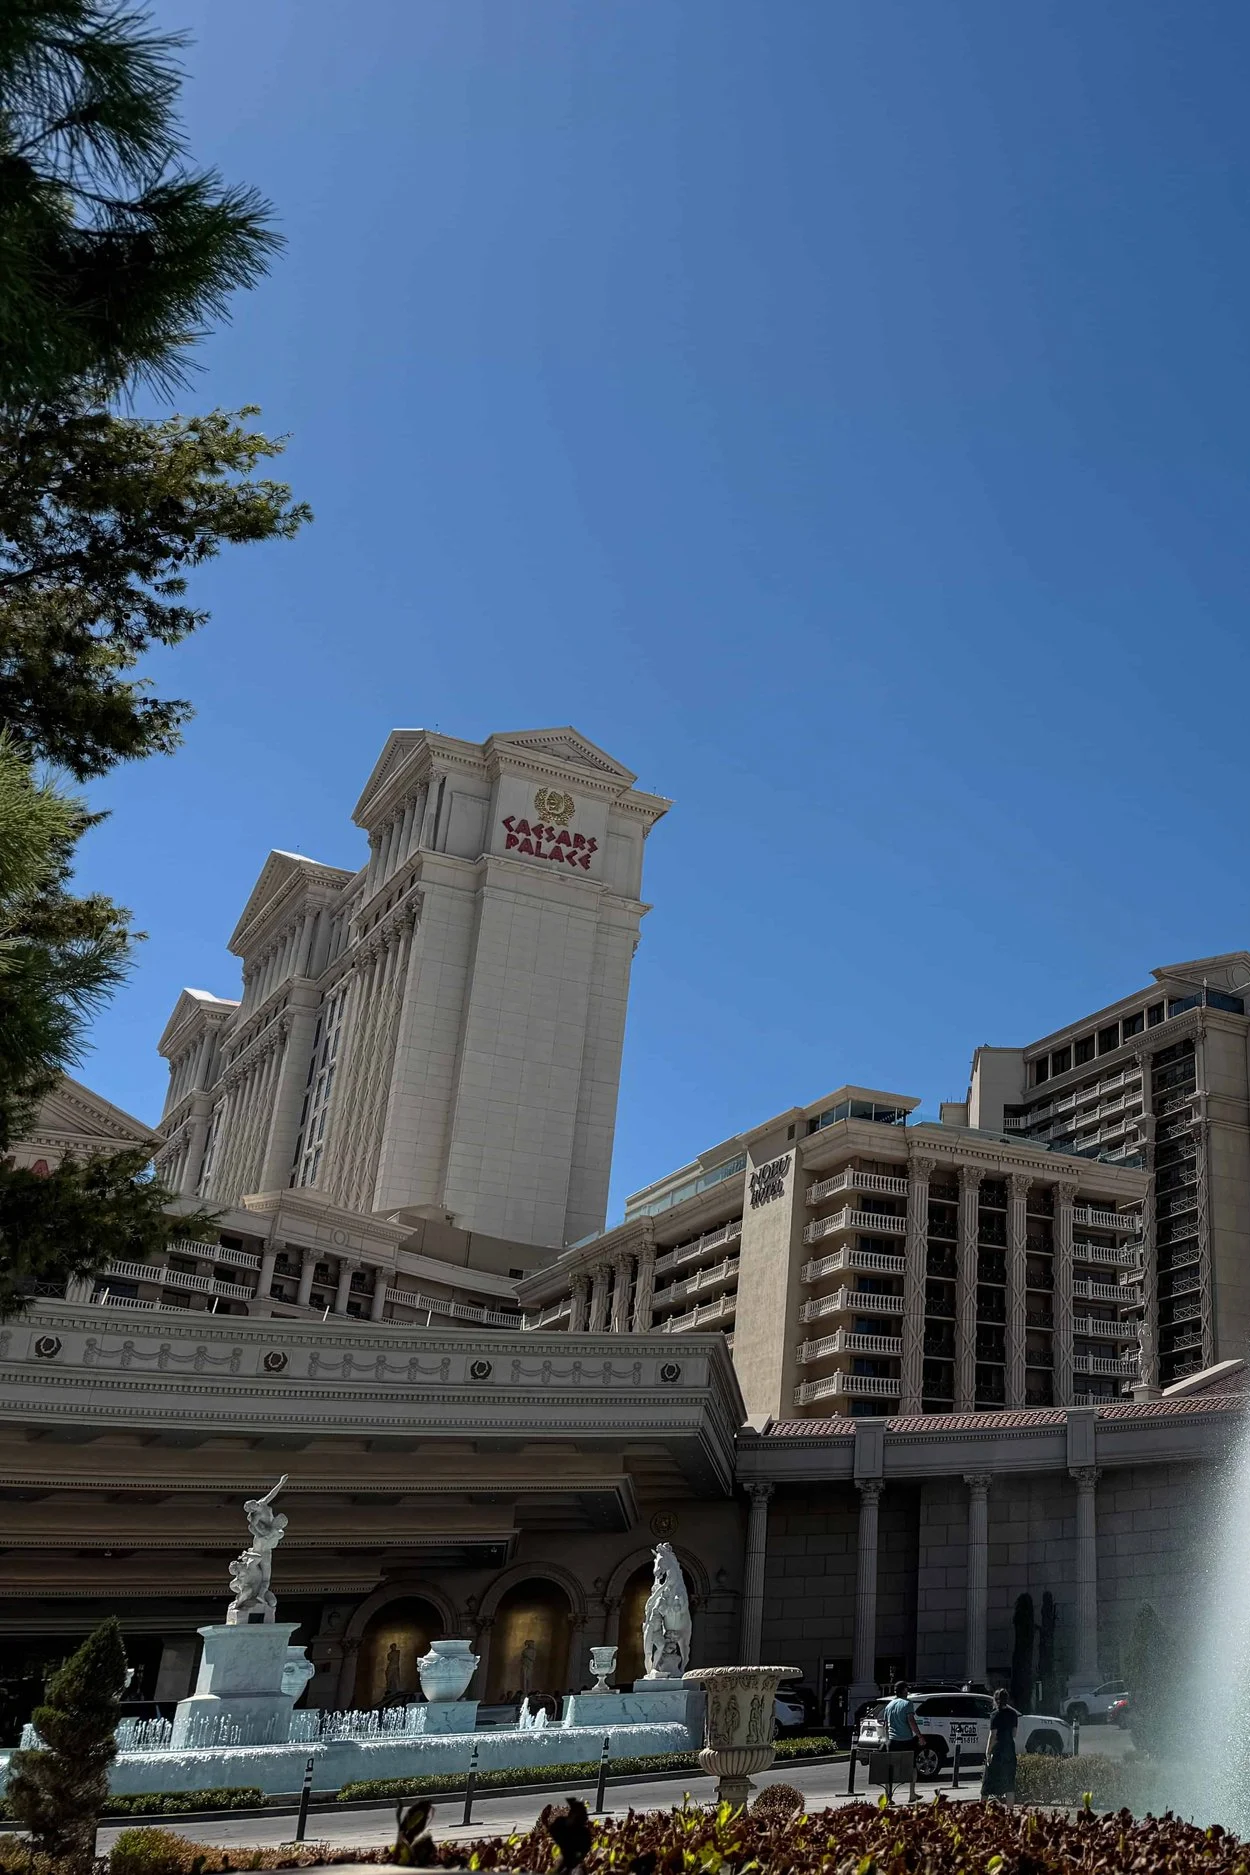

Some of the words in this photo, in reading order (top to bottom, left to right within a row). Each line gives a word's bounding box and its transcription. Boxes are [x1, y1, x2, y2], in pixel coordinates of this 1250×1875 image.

[502, 816, 598, 853] CAESARS
[505, 834, 591, 870] PALACE
[748, 1155, 790, 1188] NOBU
[750, 1179, 784, 1206] HOTEL
